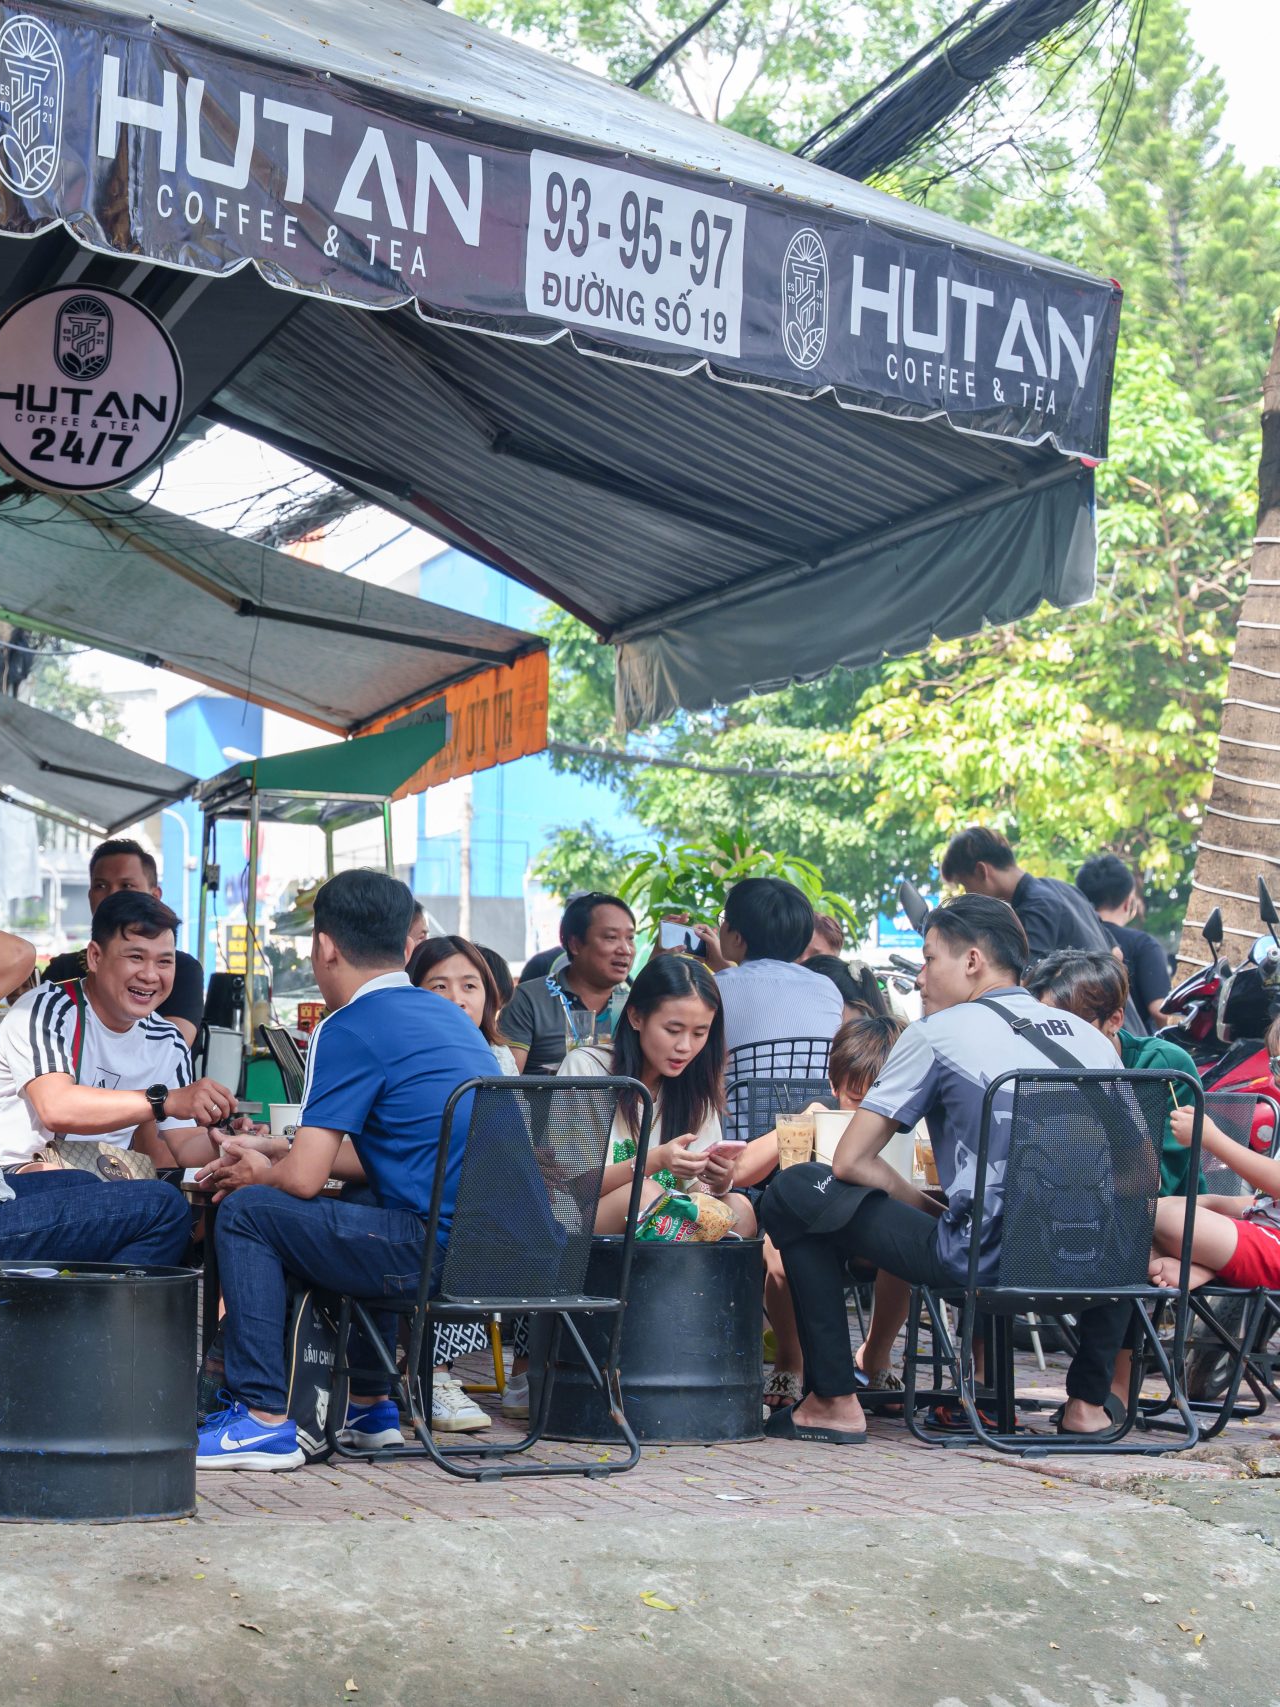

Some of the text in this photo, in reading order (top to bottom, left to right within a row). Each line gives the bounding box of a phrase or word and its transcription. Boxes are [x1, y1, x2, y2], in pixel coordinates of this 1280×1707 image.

[0, 83, 11, 97] ES
[43, 95, 55, 109] 20
[0, 100, 11, 113] TD
[42, 112, 53, 125] 21
[96, 54, 483, 248] HUTAN
[156, 184, 427, 278] COFFEE & TEA
[542, 270, 727, 345] ĐƯỜNG SỐ 19
[850, 254, 1095, 389] HUTAN
[886, 353, 1056, 416] COFFEE & TEA
[14, 413, 140, 432] COFFEE & TEA
[29, 427, 134, 468] 24/7
[103, 1166, 130, 1180] GUCCI
